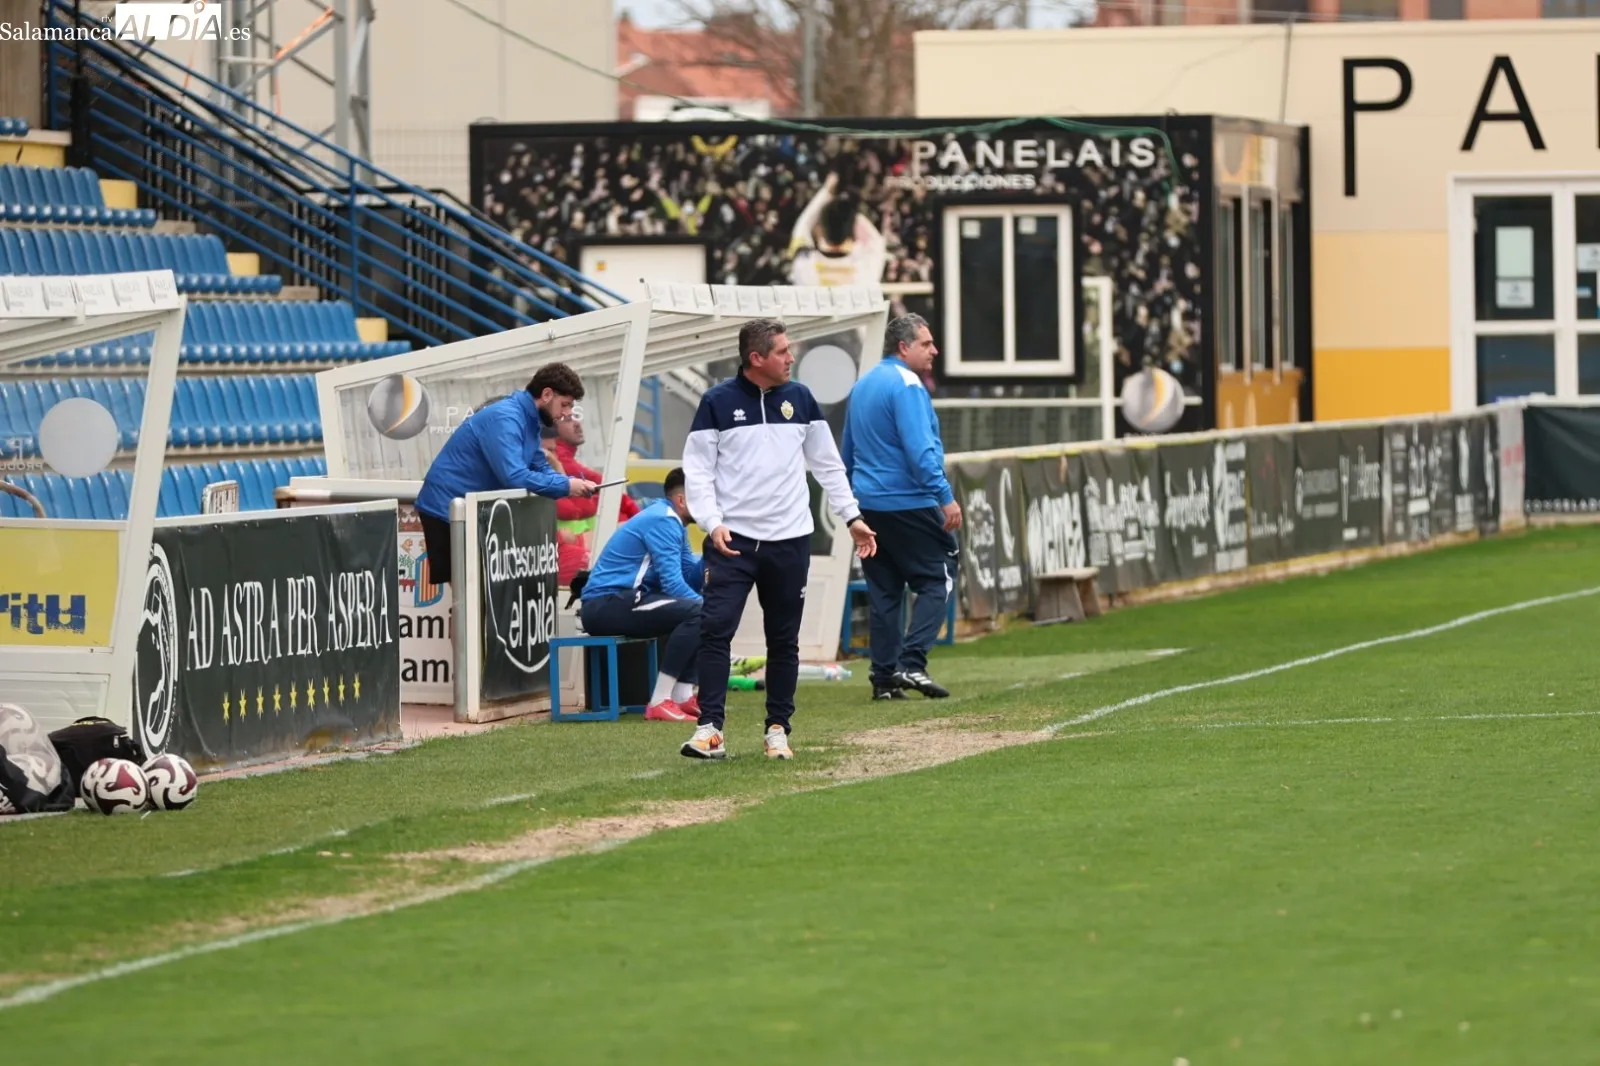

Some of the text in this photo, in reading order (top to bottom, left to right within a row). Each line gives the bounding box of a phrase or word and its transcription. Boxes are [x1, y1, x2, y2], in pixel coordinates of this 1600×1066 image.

[912, 137, 1156, 176] PANELAIS
[489, 532, 559, 582] autoescuelas
[186, 587, 215, 671] AD
[220, 578, 282, 665] ASTRA
[287, 574, 322, 657] PER
[326, 567, 393, 652] ASPERA
[508, 582, 559, 662] el pila
[401, 658, 455, 683] am
